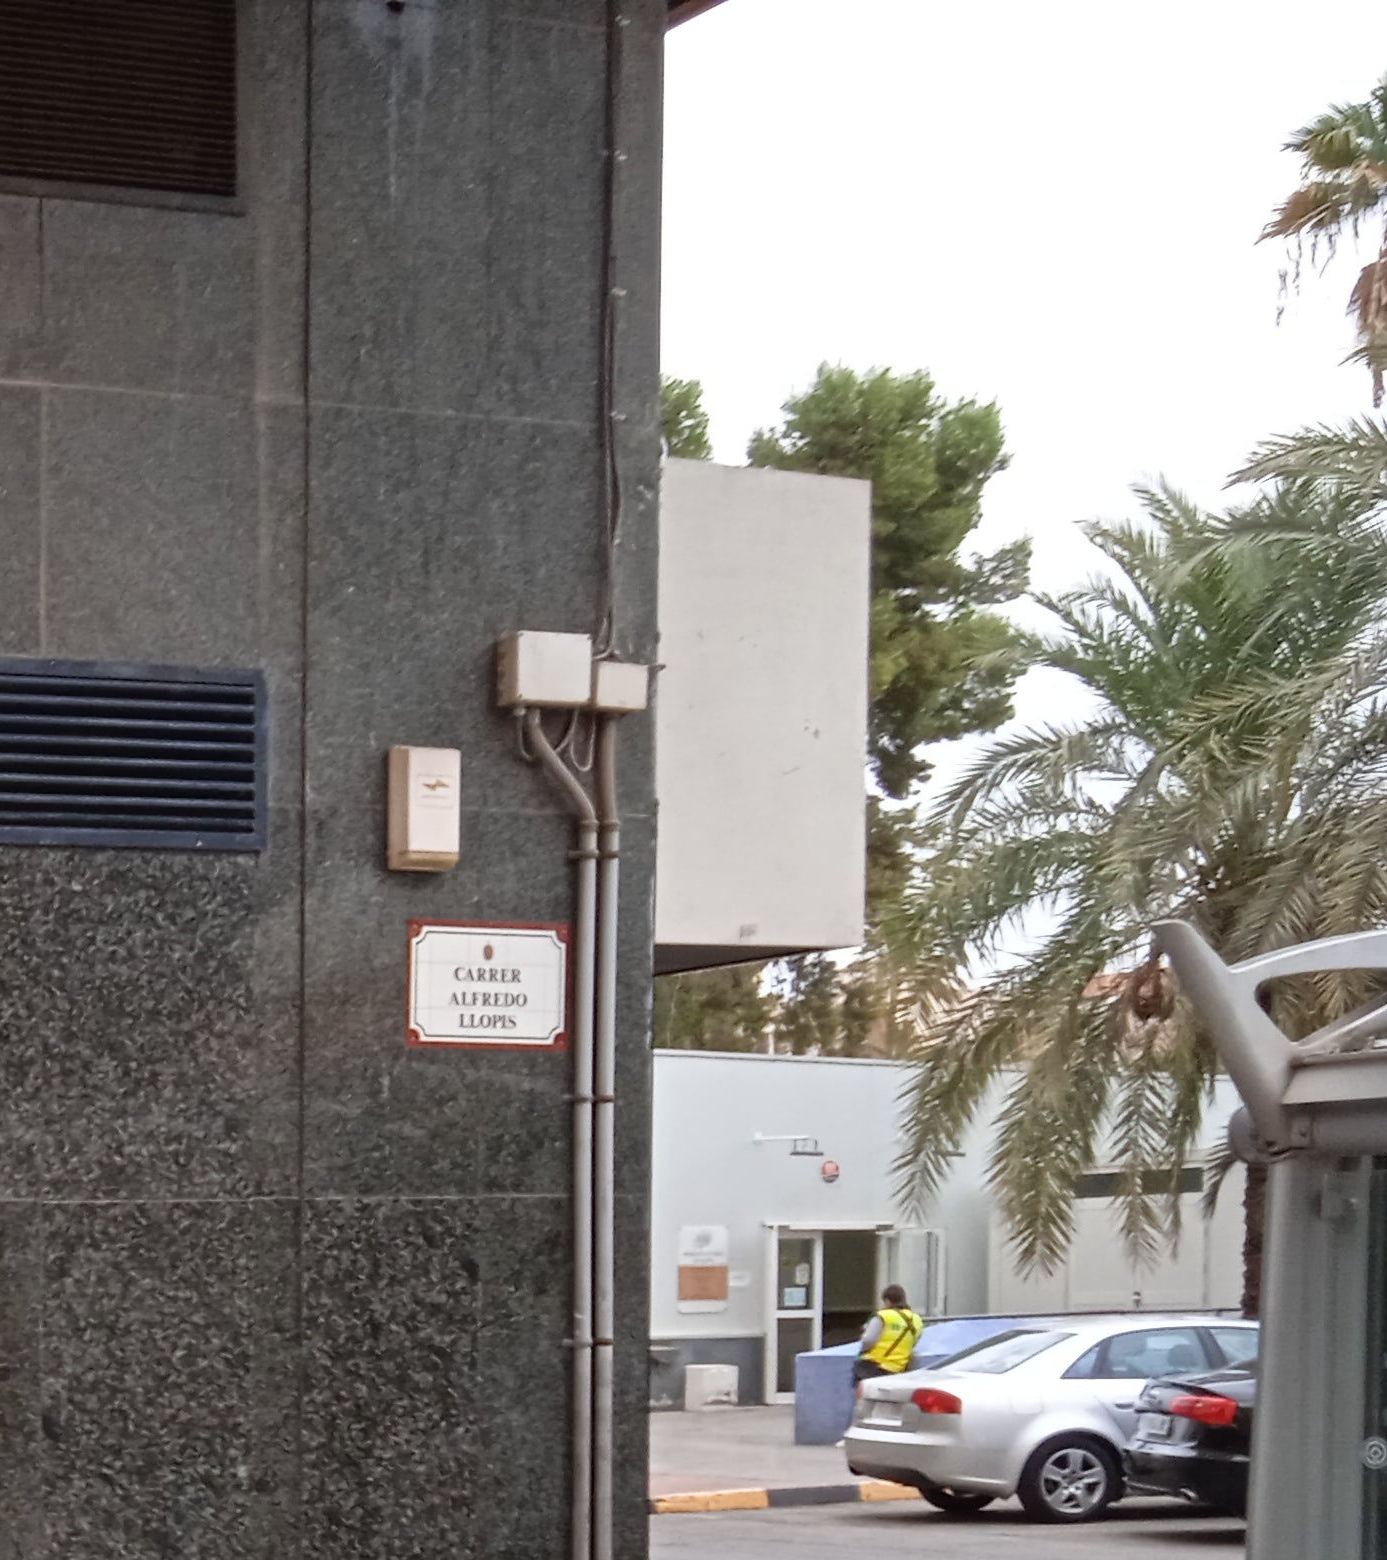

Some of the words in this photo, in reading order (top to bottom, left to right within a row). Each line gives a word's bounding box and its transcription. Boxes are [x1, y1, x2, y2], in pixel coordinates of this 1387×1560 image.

[454, 966, 522, 984] CARRER
[449, 991, 528, 1008] ALFREDO
[459, 1013, 518, 1029] LLOPIS
